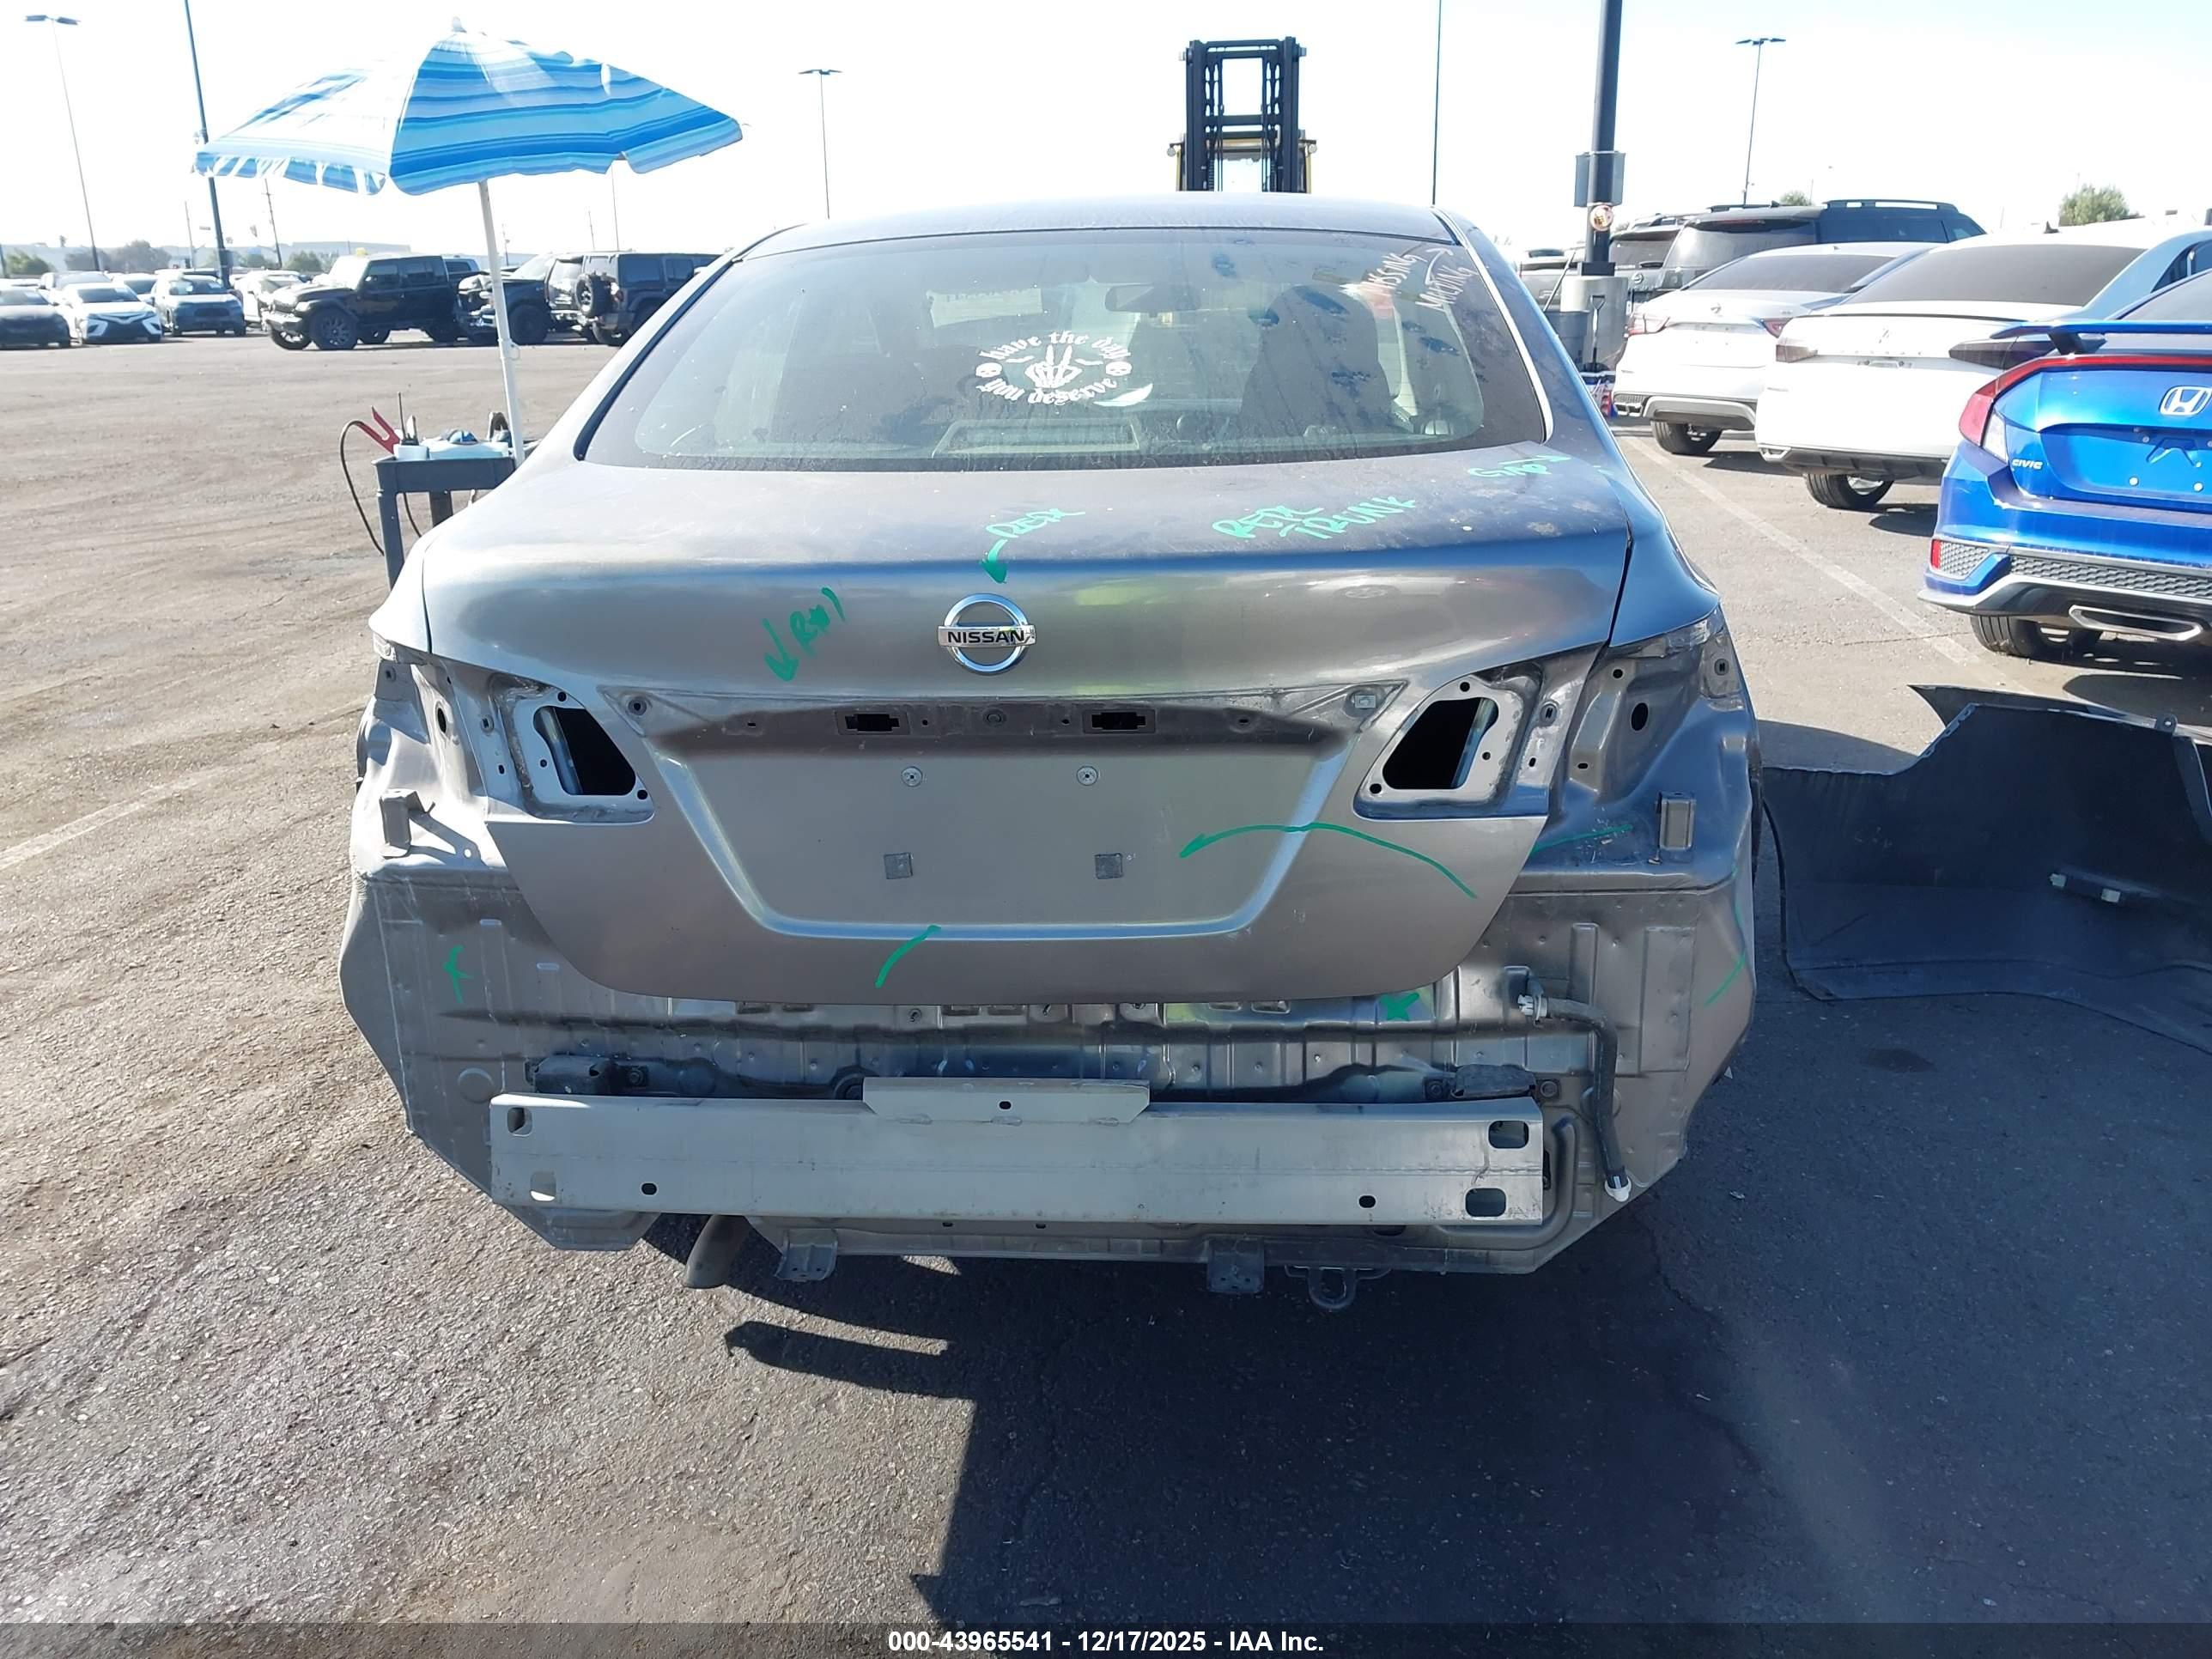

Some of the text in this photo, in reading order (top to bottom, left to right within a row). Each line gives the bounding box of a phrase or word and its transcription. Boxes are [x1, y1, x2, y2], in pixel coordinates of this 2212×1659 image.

[1048, 330, 1089, 345] the
[1027, 377, 1117, 405] deserve
[2012, 458, 2044, 470] CIVIC
[1279, 495, 1416, 540] TRUNK
[947, 630, 1024, 644] NISSAN
